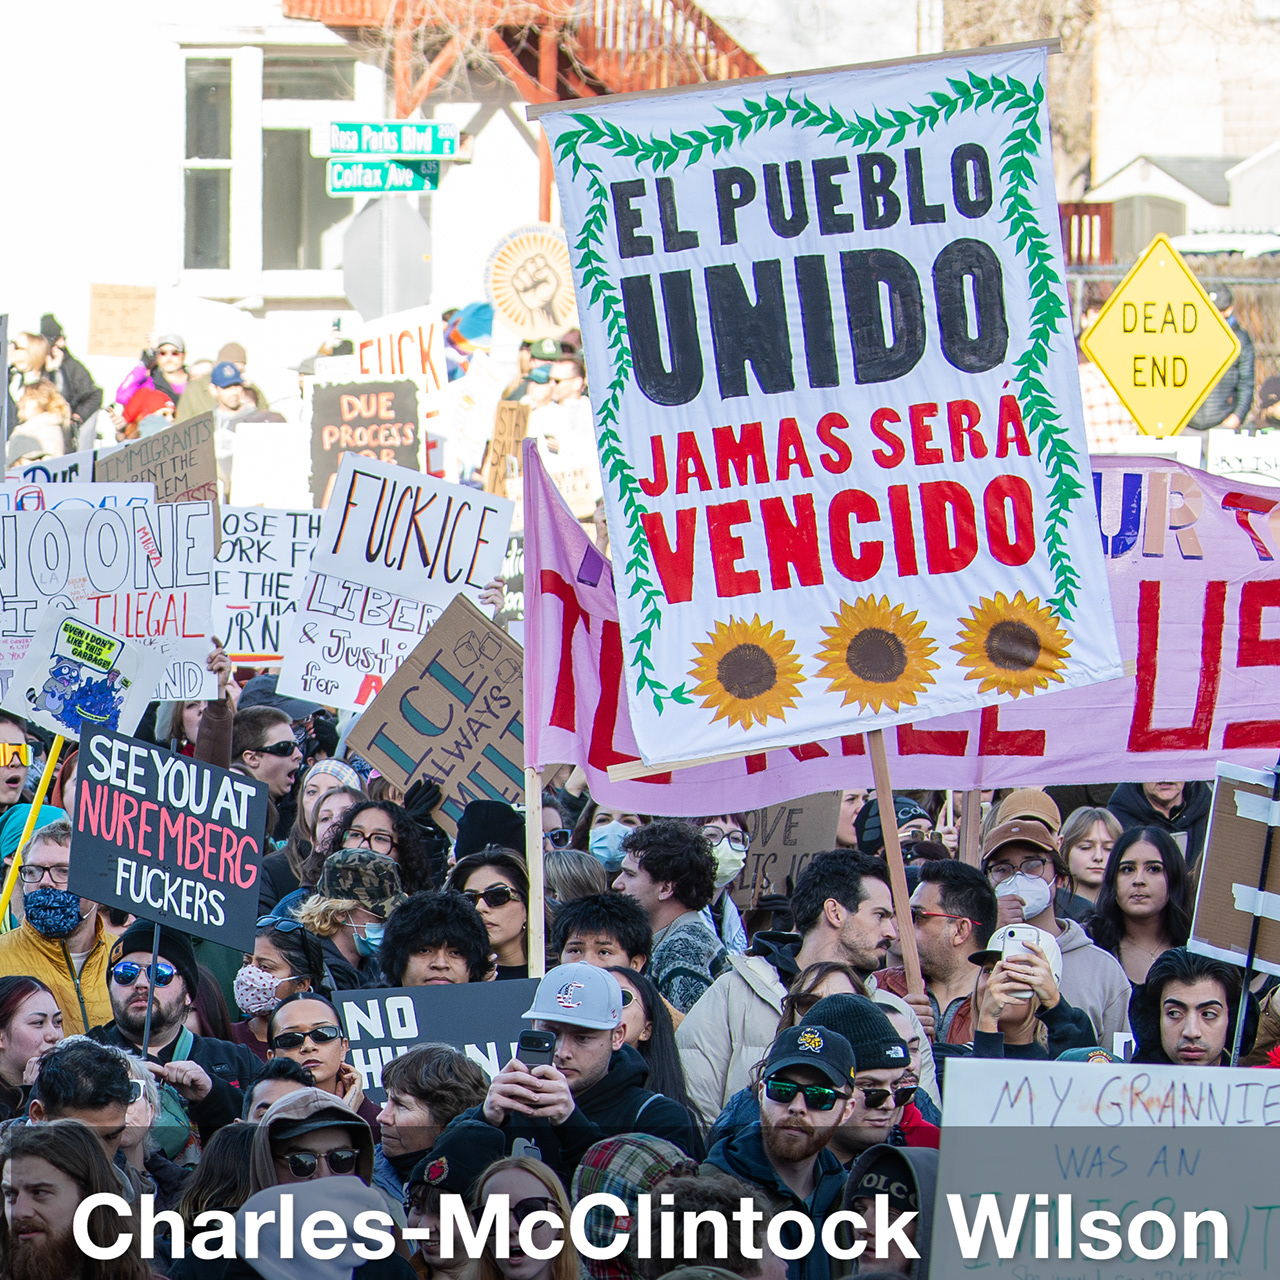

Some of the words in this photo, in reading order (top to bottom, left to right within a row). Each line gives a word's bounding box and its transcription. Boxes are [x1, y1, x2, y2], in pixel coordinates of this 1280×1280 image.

[331, 125, 358, 150] Rosa
[362, 125, 398, 152] Parks
[402, 125, 432, 151] Blvd
[438, 125, 456, 137] 200
[332, 164, 382, 187] Colfax
[386, 162, 414, 187] Ave
[611, 175, 699, 259] EL
[712, 142, 993, 245] PUEBLO
[621, 239, 1009, 404] UNIDO
[1122, 300, 1198, 334] DEAD
[1132, 356, 1189, 389] END
[341, 392, 395, 421] DUE
[101, 418, 212, 481] IMMIGRANTS
[323, 424, 415, 450] PROCESS
[639, 412, 852, 498] JAMAS
[84, 501, 210, 593] ONE
[643, 475, 1037, 604] VENCIDO
[62, 623, 84, 638] EVEN
[90, 635, 115, 649] DON'T
[66, 637, 83, 650] LIKE
[85, 644, 102, 656] THIS
[71, 648, 112, 670] GARBAGE!
[87, 735, 147, 795] SEE
[150, 746, 212, 814] YOU
[214, 772, 256, 831] AT
[78, 780, 258, 889] NUREMBERG
[116, 857, 225, 928] FUCKERS
[342, 996, 418, 1039] NO
[990, 1077, 1073, 1127] MY
[1096, 1073, 1280, 1128] GRANNIE
[1055, 1144, 1128, 1179] WAS
[1147, 1145, 1201, 1178] AN
